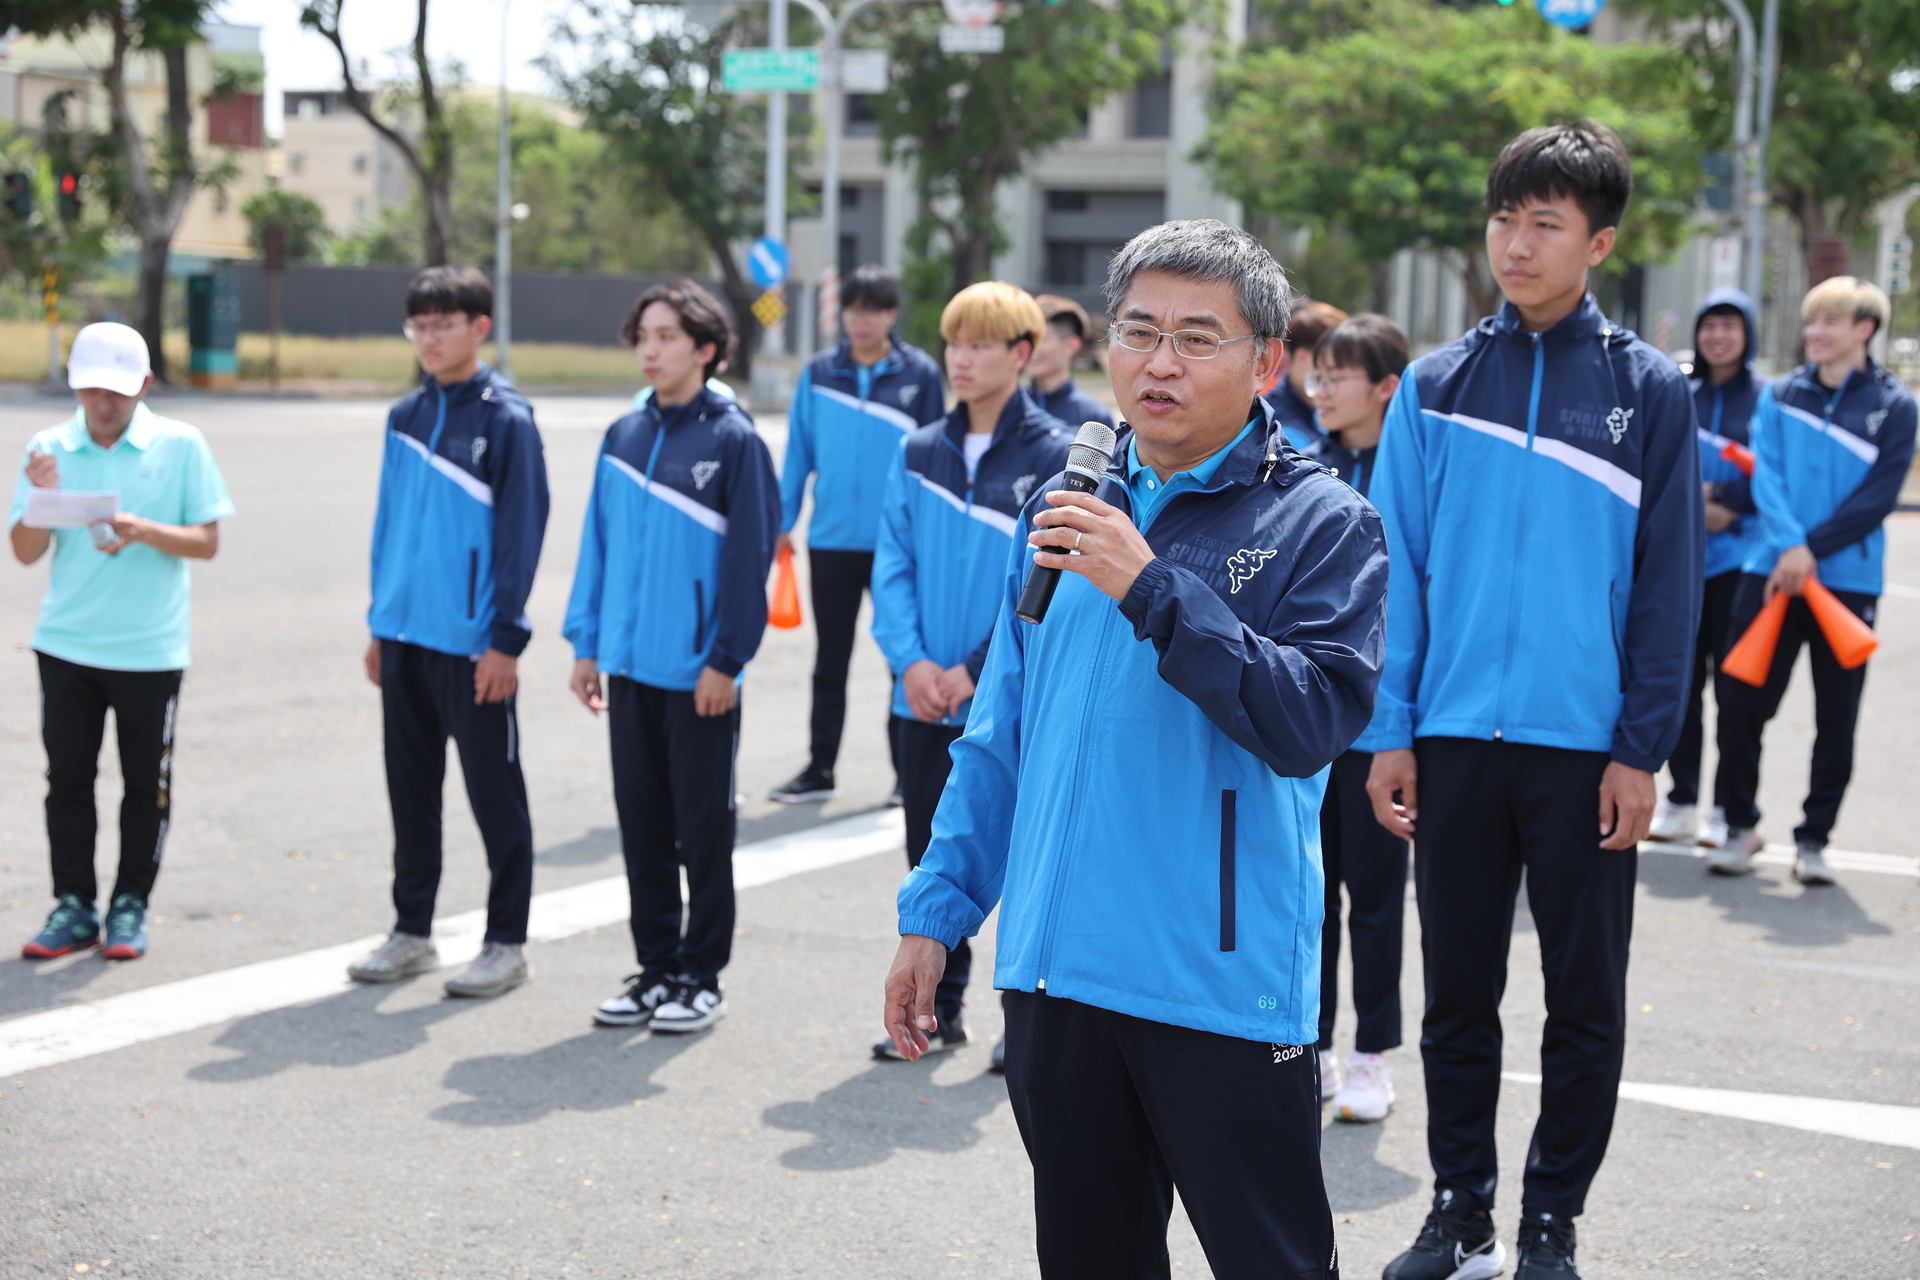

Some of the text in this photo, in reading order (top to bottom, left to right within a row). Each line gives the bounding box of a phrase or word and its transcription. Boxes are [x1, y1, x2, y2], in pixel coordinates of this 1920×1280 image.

[1560, 408, 1607, 429] SPIRIT
[1070, 479, 1085, 488] TEV
[1194, 534, 1217, 549] FOR
[1166, 543, 1230, 571] SPIRIT
[1258, 995, 1277, 1010] 69
[1273, 1045, 1304, 1064] 2020
